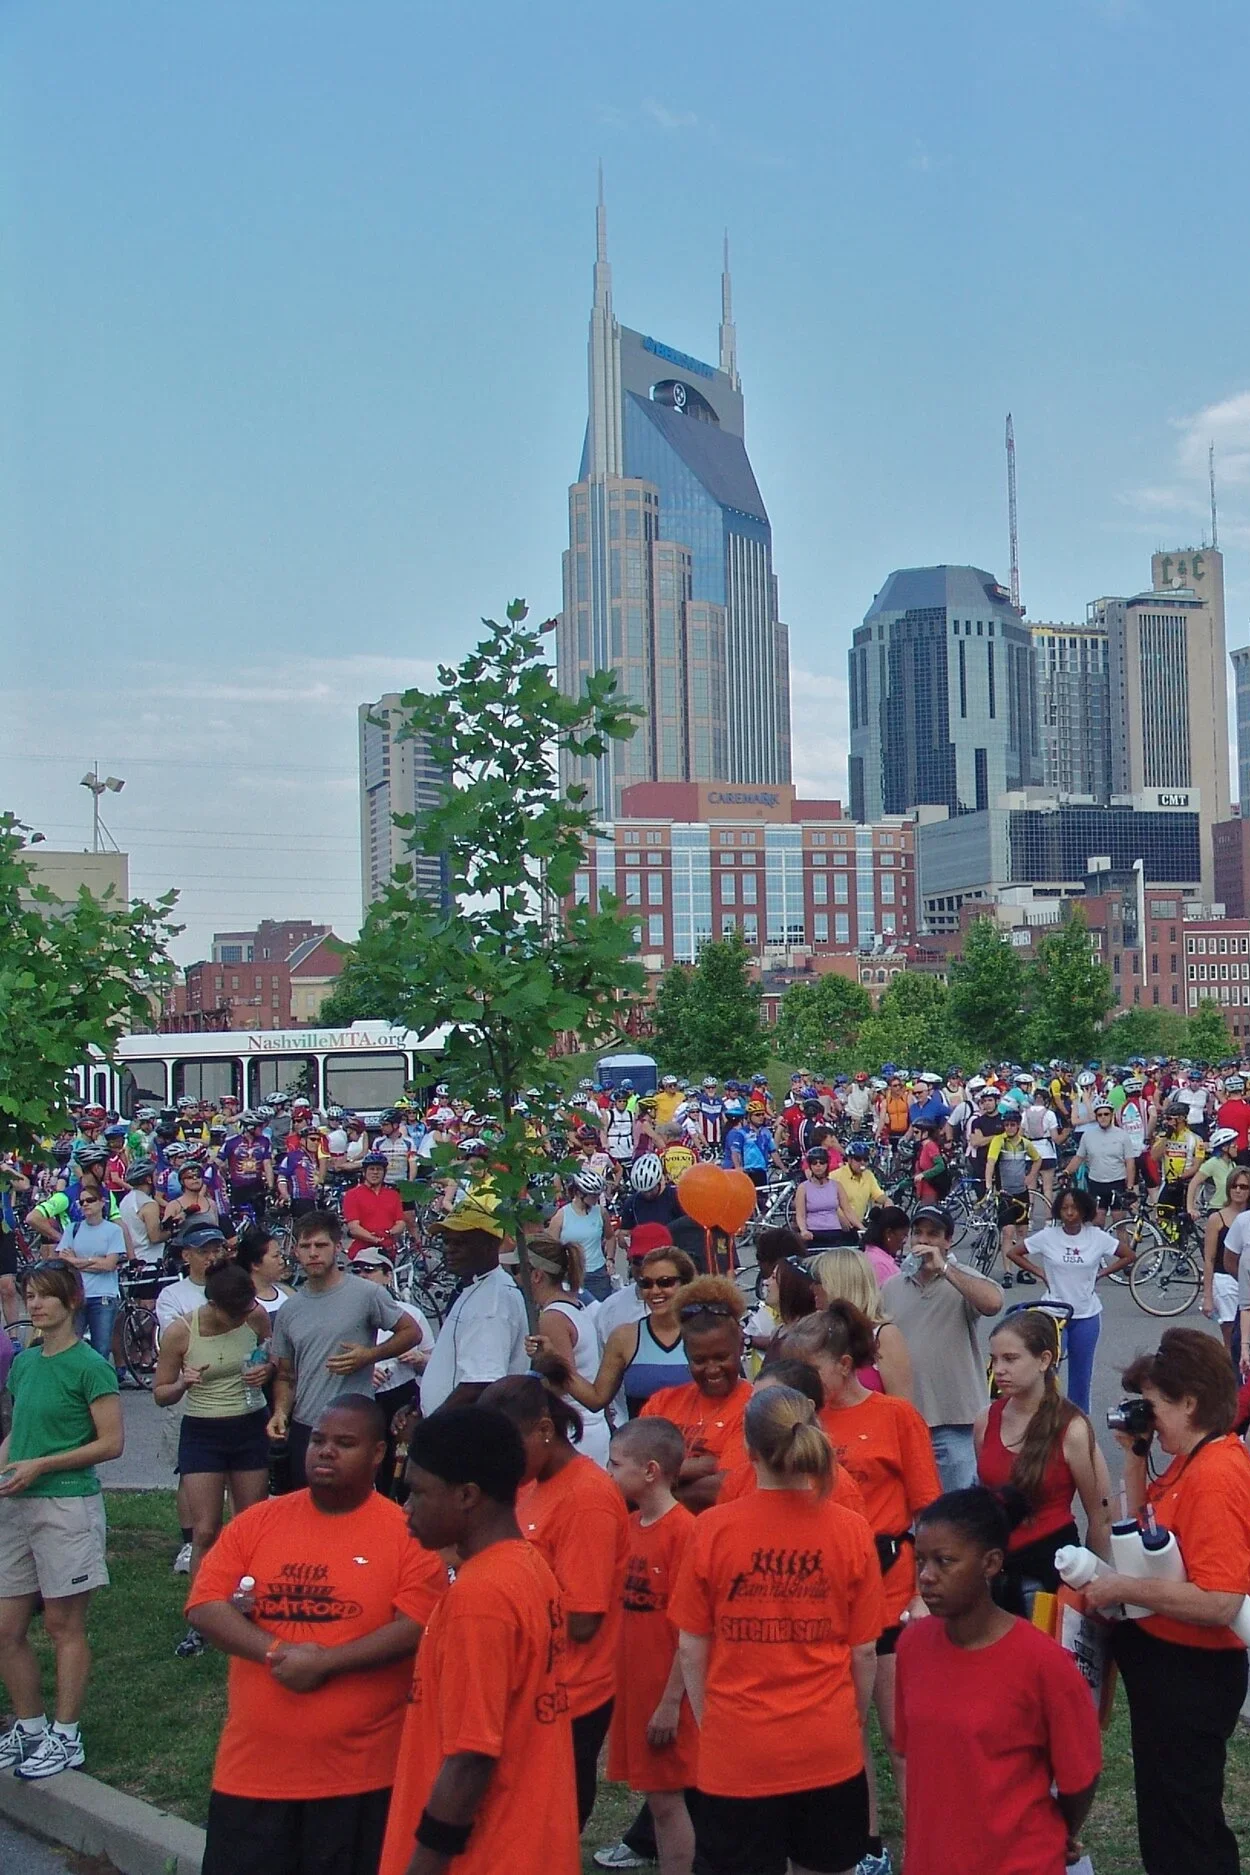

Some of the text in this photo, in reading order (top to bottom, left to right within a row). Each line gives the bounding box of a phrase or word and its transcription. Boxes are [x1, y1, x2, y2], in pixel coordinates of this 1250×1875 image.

[707, 791, 780, 809] CAREMARK
[1161, 794, 1187, 806] CMT
[248, 1031, 405, 1050] NashvilleMTA.org
